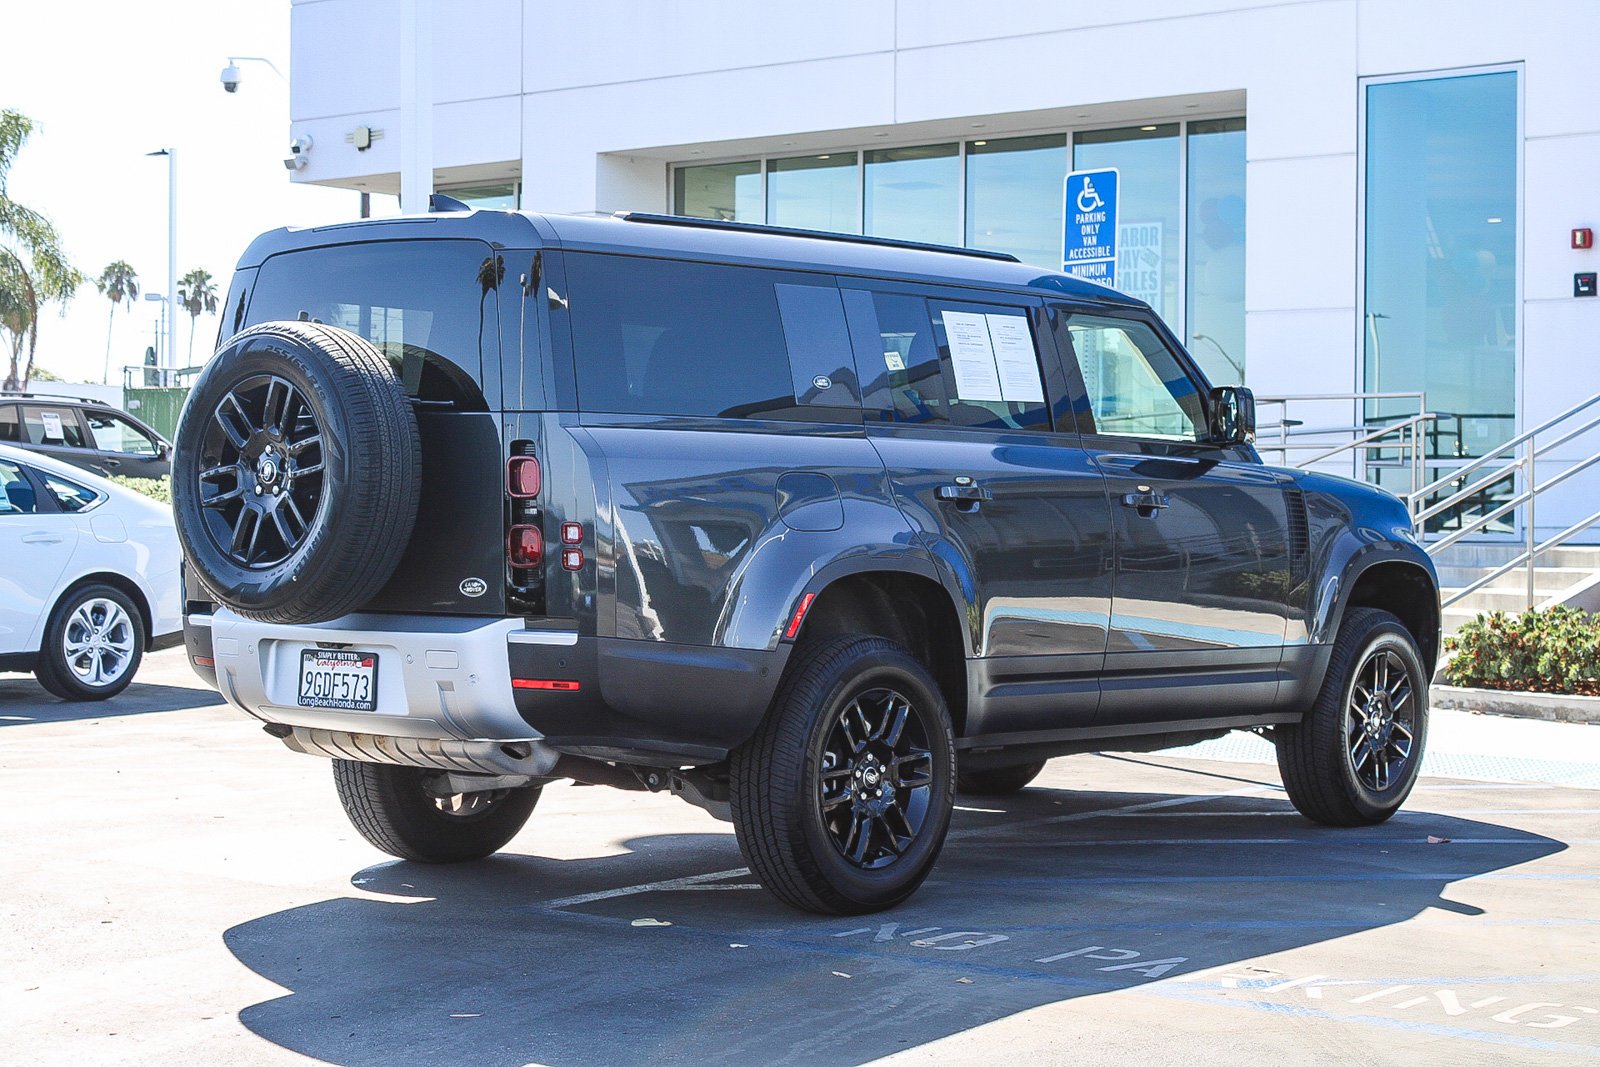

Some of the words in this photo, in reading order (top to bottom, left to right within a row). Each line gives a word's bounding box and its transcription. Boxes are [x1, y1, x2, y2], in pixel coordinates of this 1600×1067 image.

[1076, 212, 1106, 224] PARKING
[1081, 224, 1100, 236] ONLY
[1083, 236, 1097, 246] VAN
[1119, 226, 1159, 248] ABOR
[1069, 246, 1111, 259] ACCESSIBLE
[1072, 263, 1107, 278] MINIMUM
[317, 651, 337, 660] SIMPLY
[304, 671, 369, 700] 9GDF573
[299, 696, 371, 710] LongBeachHonda.com
